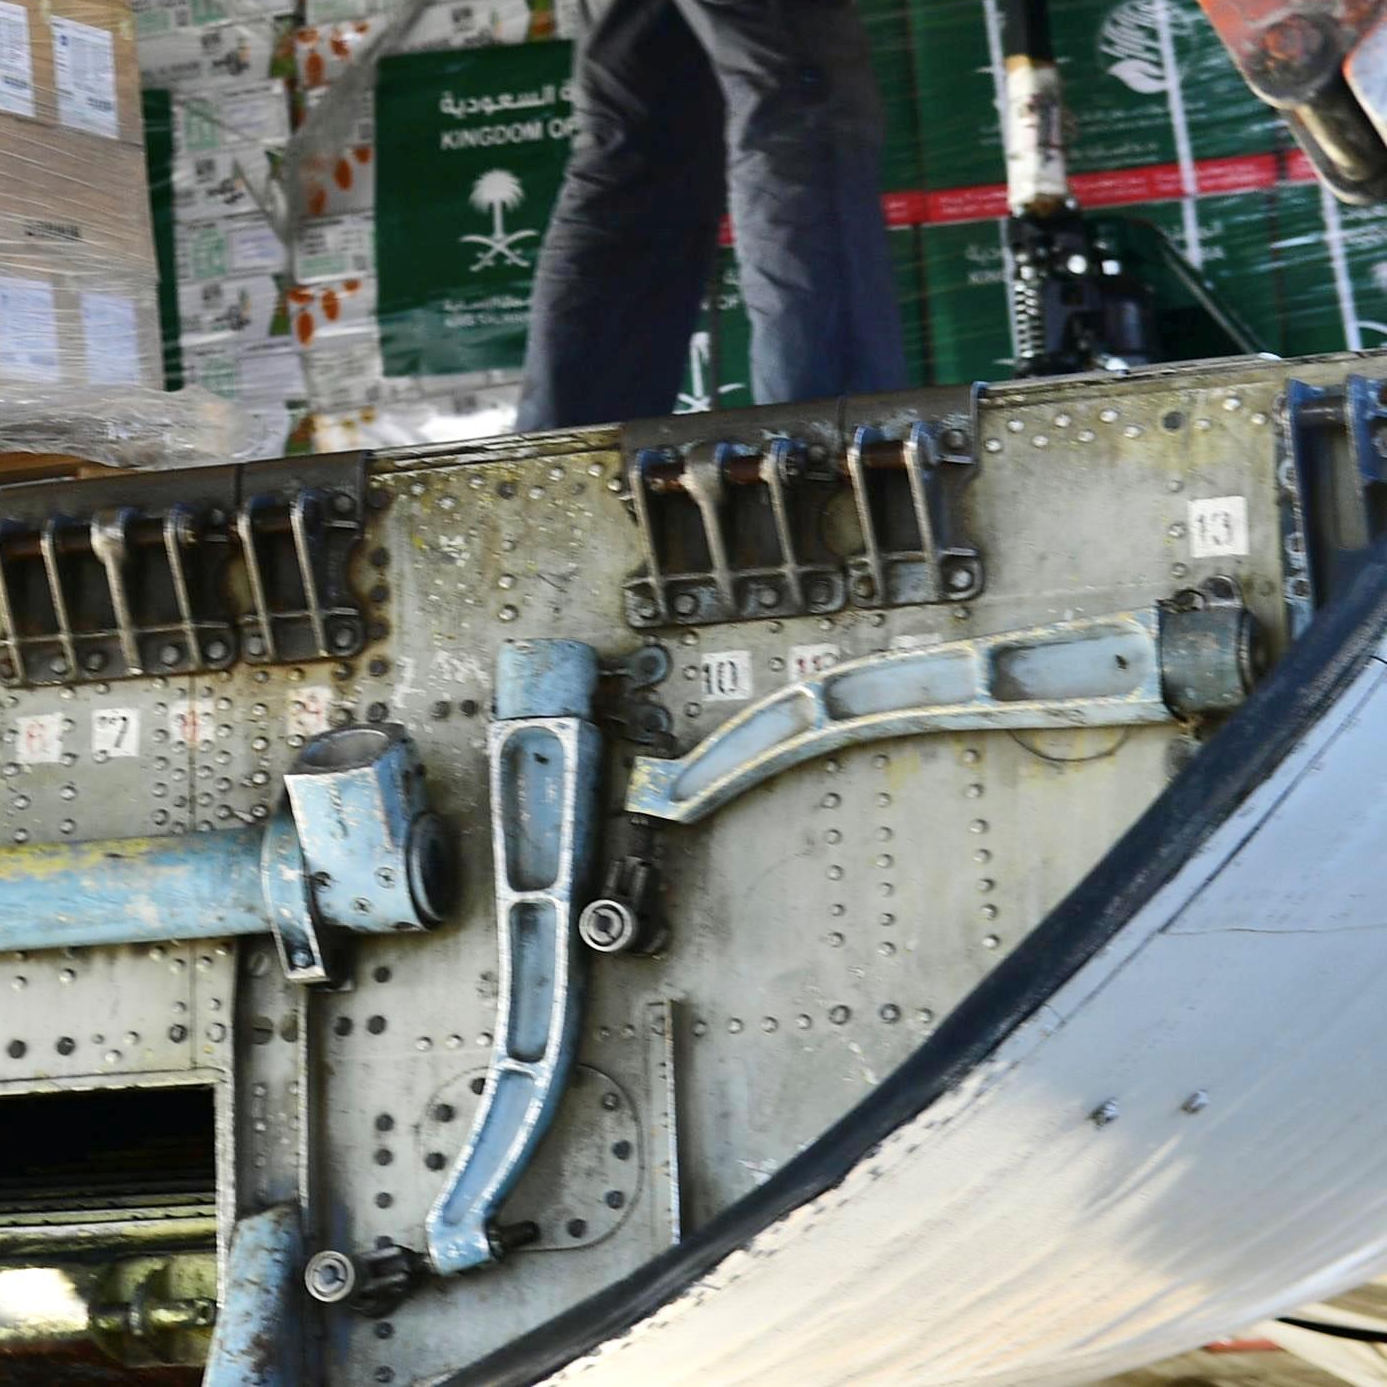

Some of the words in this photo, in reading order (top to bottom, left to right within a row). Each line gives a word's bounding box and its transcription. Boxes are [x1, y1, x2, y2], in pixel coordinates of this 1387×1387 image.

[439, 82, 556, 119] السعودية
[440, 120, 544, 150] KINGDOM
[700, 659, 736, 695] 10
[98, 714, 127, 749] 7
